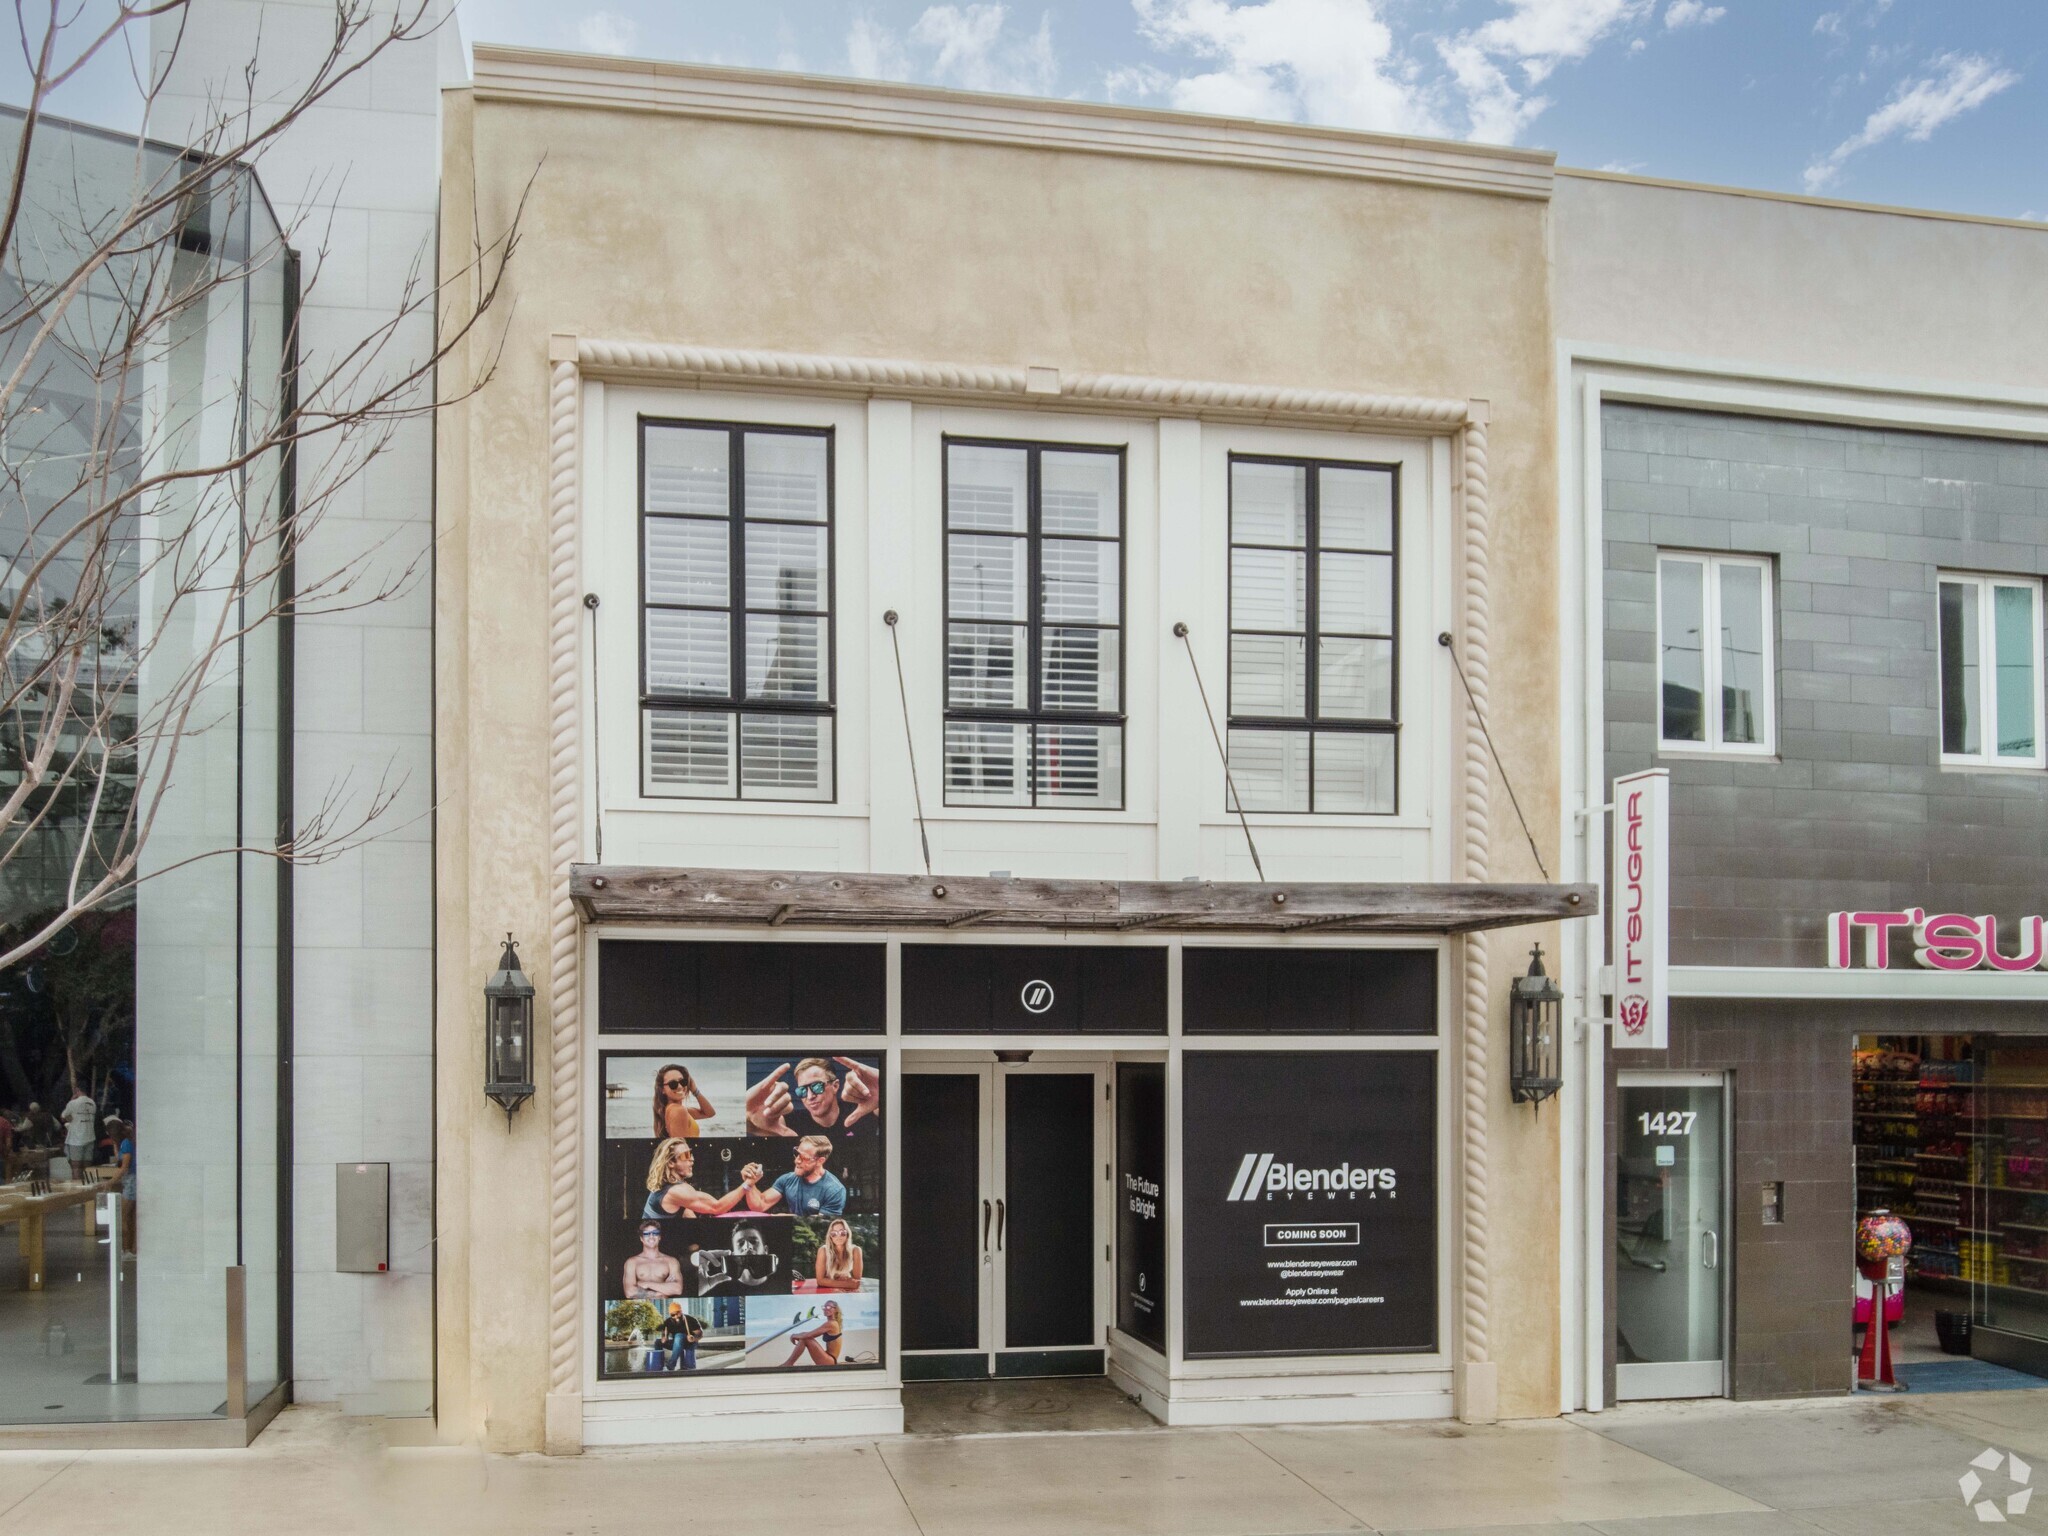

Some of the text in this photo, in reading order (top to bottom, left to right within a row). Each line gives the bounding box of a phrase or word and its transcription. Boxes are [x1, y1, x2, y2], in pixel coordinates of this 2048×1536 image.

[1626, 791, 1643, 983] IT'SUGAR
[1829, 907, 2048, 971] IT'SU
[1638, 1111, 1697, 1136] 1427
[1266, 1162, 1397, 1191] Blenders
[1125, 1173, 1159, 1197] The Future
[1266, 1190, 1397, 1201] EYEWEAR
[1130, 1195, 1136, 1212] is
[1277, 1229, 1347, 1240] COMING SOON
[1267, 1259, 1358, 1269] www.blenderseyewear.com
[1280, 1269, 1345, 1279] @blenderseyewear
[1285, 1287, 1339, 1297] Apply Online at
[1240, 1295, 1385, 1307] www.blenderseyewear.com/pages/careers
